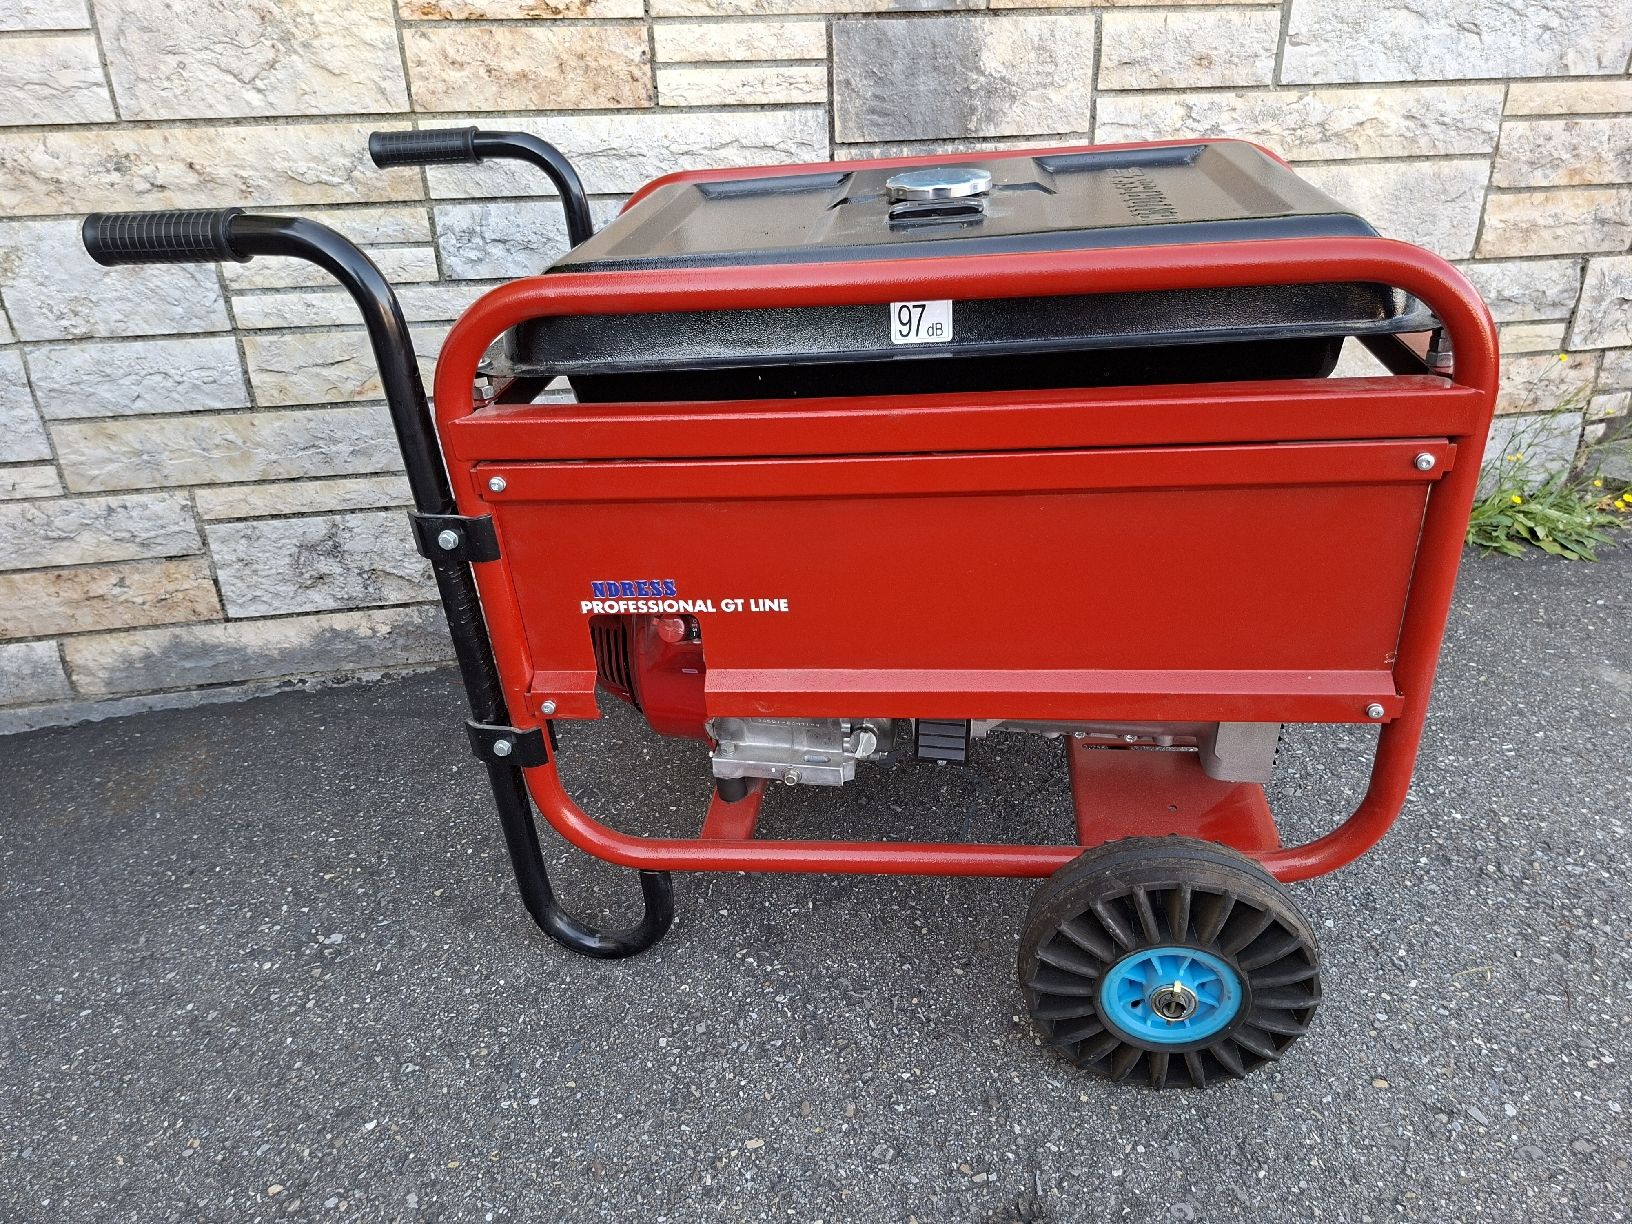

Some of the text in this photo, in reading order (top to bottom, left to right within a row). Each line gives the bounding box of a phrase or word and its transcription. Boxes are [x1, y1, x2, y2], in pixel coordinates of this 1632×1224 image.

[898, 304, 943, 337] 97 dB
[591, 579, 677, 598] NDRESS
[580, 598, 789, 614] PROFESSIONAL GT LINE
